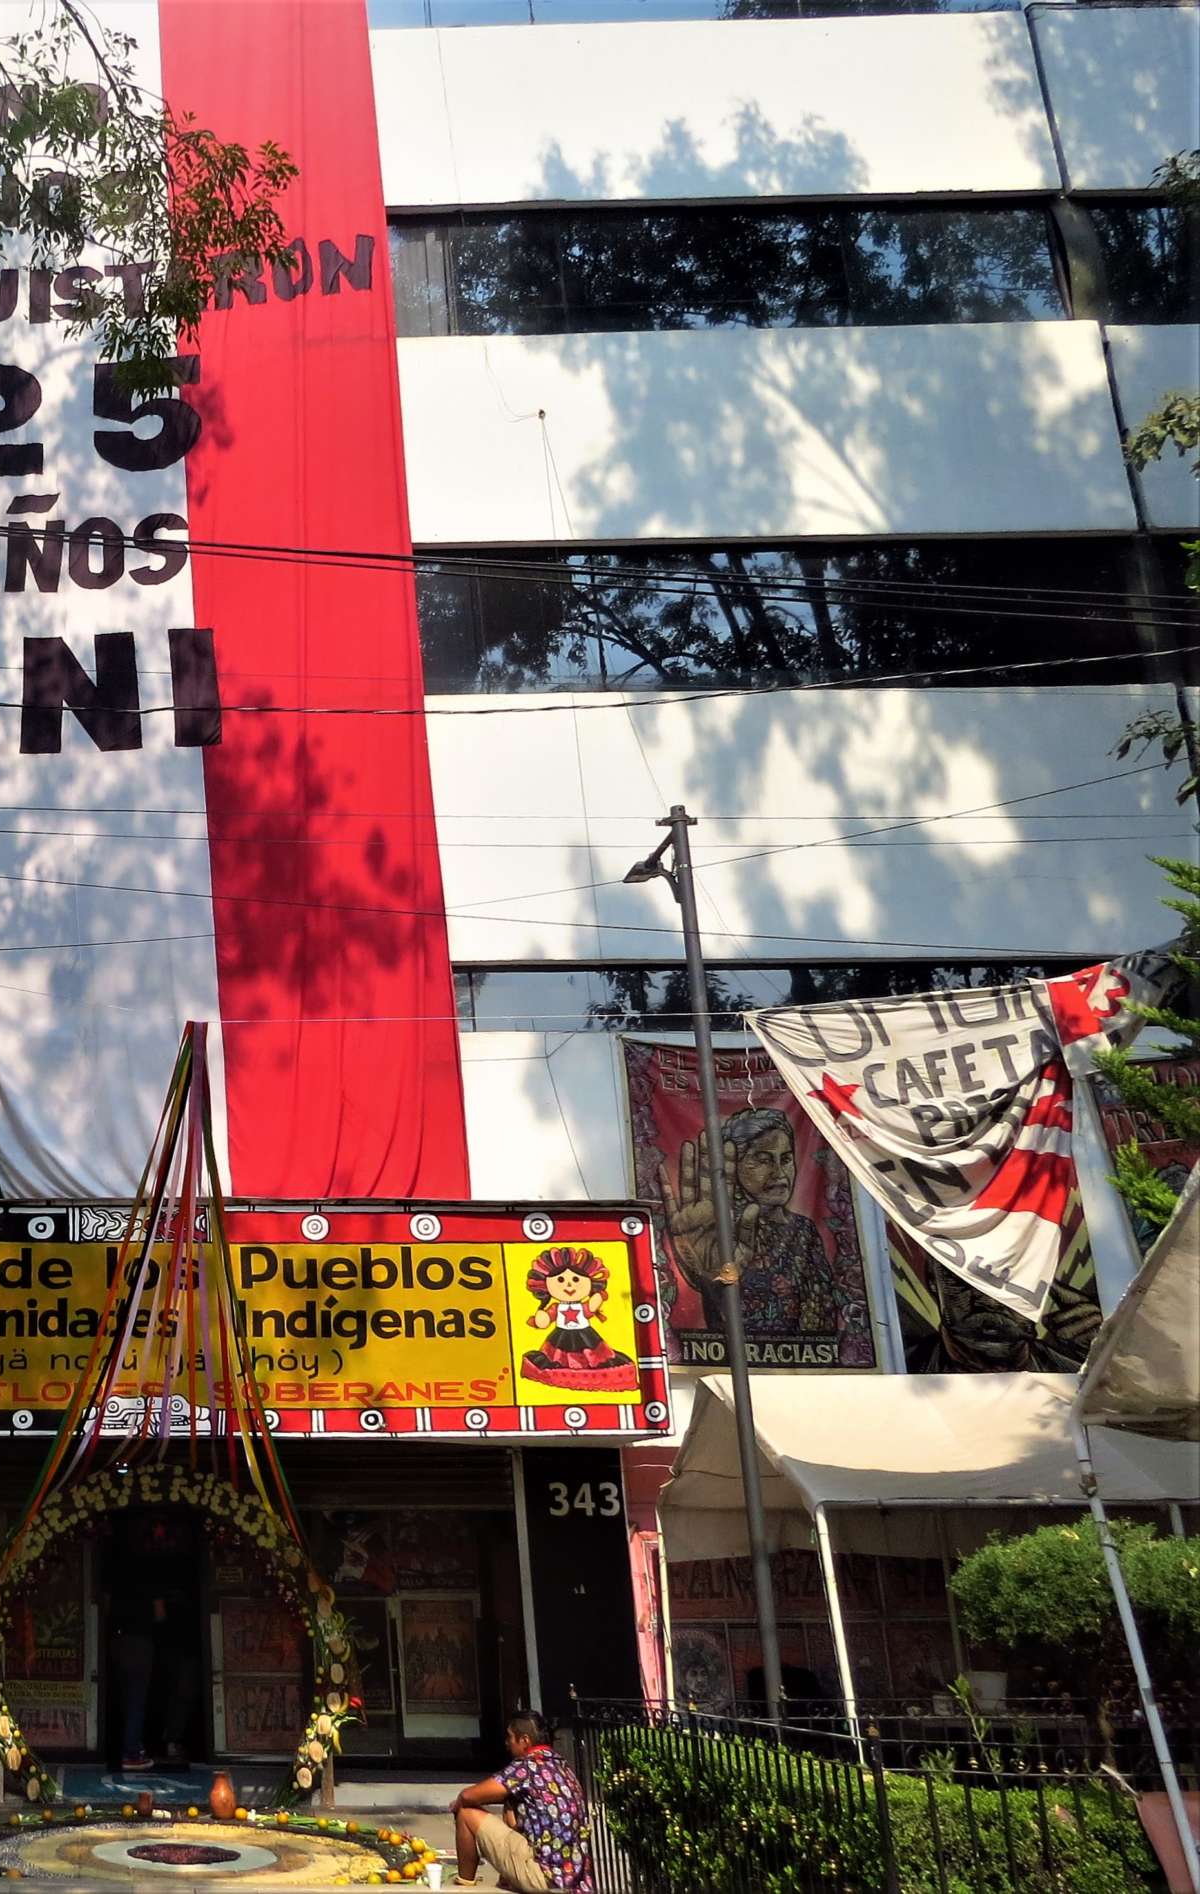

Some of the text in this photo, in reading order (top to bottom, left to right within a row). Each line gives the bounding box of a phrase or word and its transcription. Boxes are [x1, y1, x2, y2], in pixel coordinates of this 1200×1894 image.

[660, 1072, 690, 1091] ES
[239, 1246, 494, 1291] Pueblos
[924, 1233, 1050, 1311] DEL
[236, 1294, 497, 1350] Indígenas
[683, 1341, 840, 1364] ¡NO RACIAS!
[548, 1481, 621, 1517] 343
